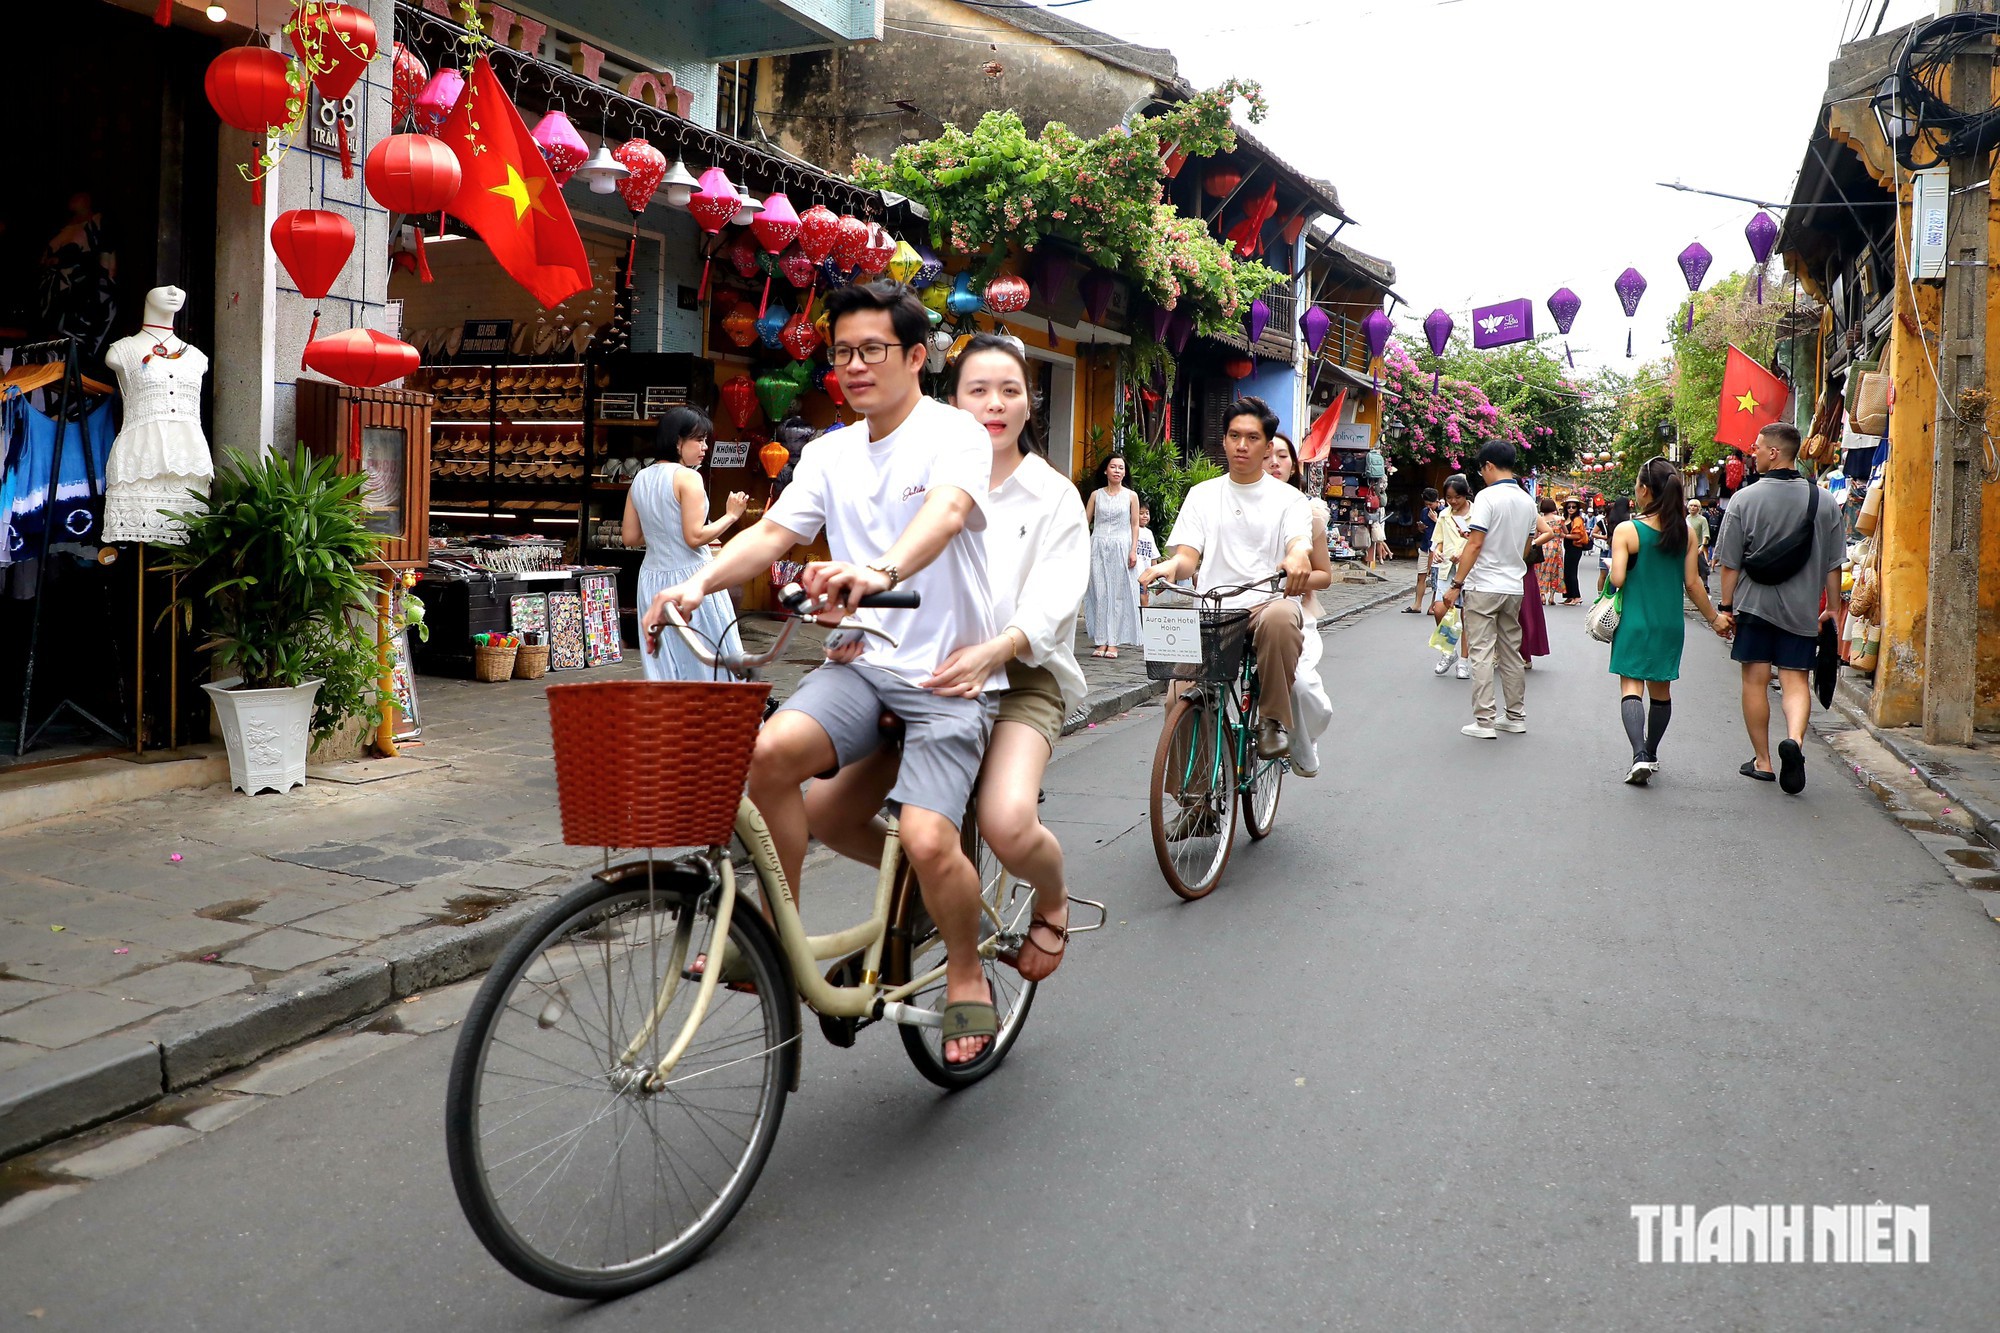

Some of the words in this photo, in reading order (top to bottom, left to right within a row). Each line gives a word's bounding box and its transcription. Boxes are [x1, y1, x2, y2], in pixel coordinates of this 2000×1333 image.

[320, 95, 356, 131] 88
[313, 127, 338, 147] TRẦN
[1331, 431, 1356, 443] ipling
